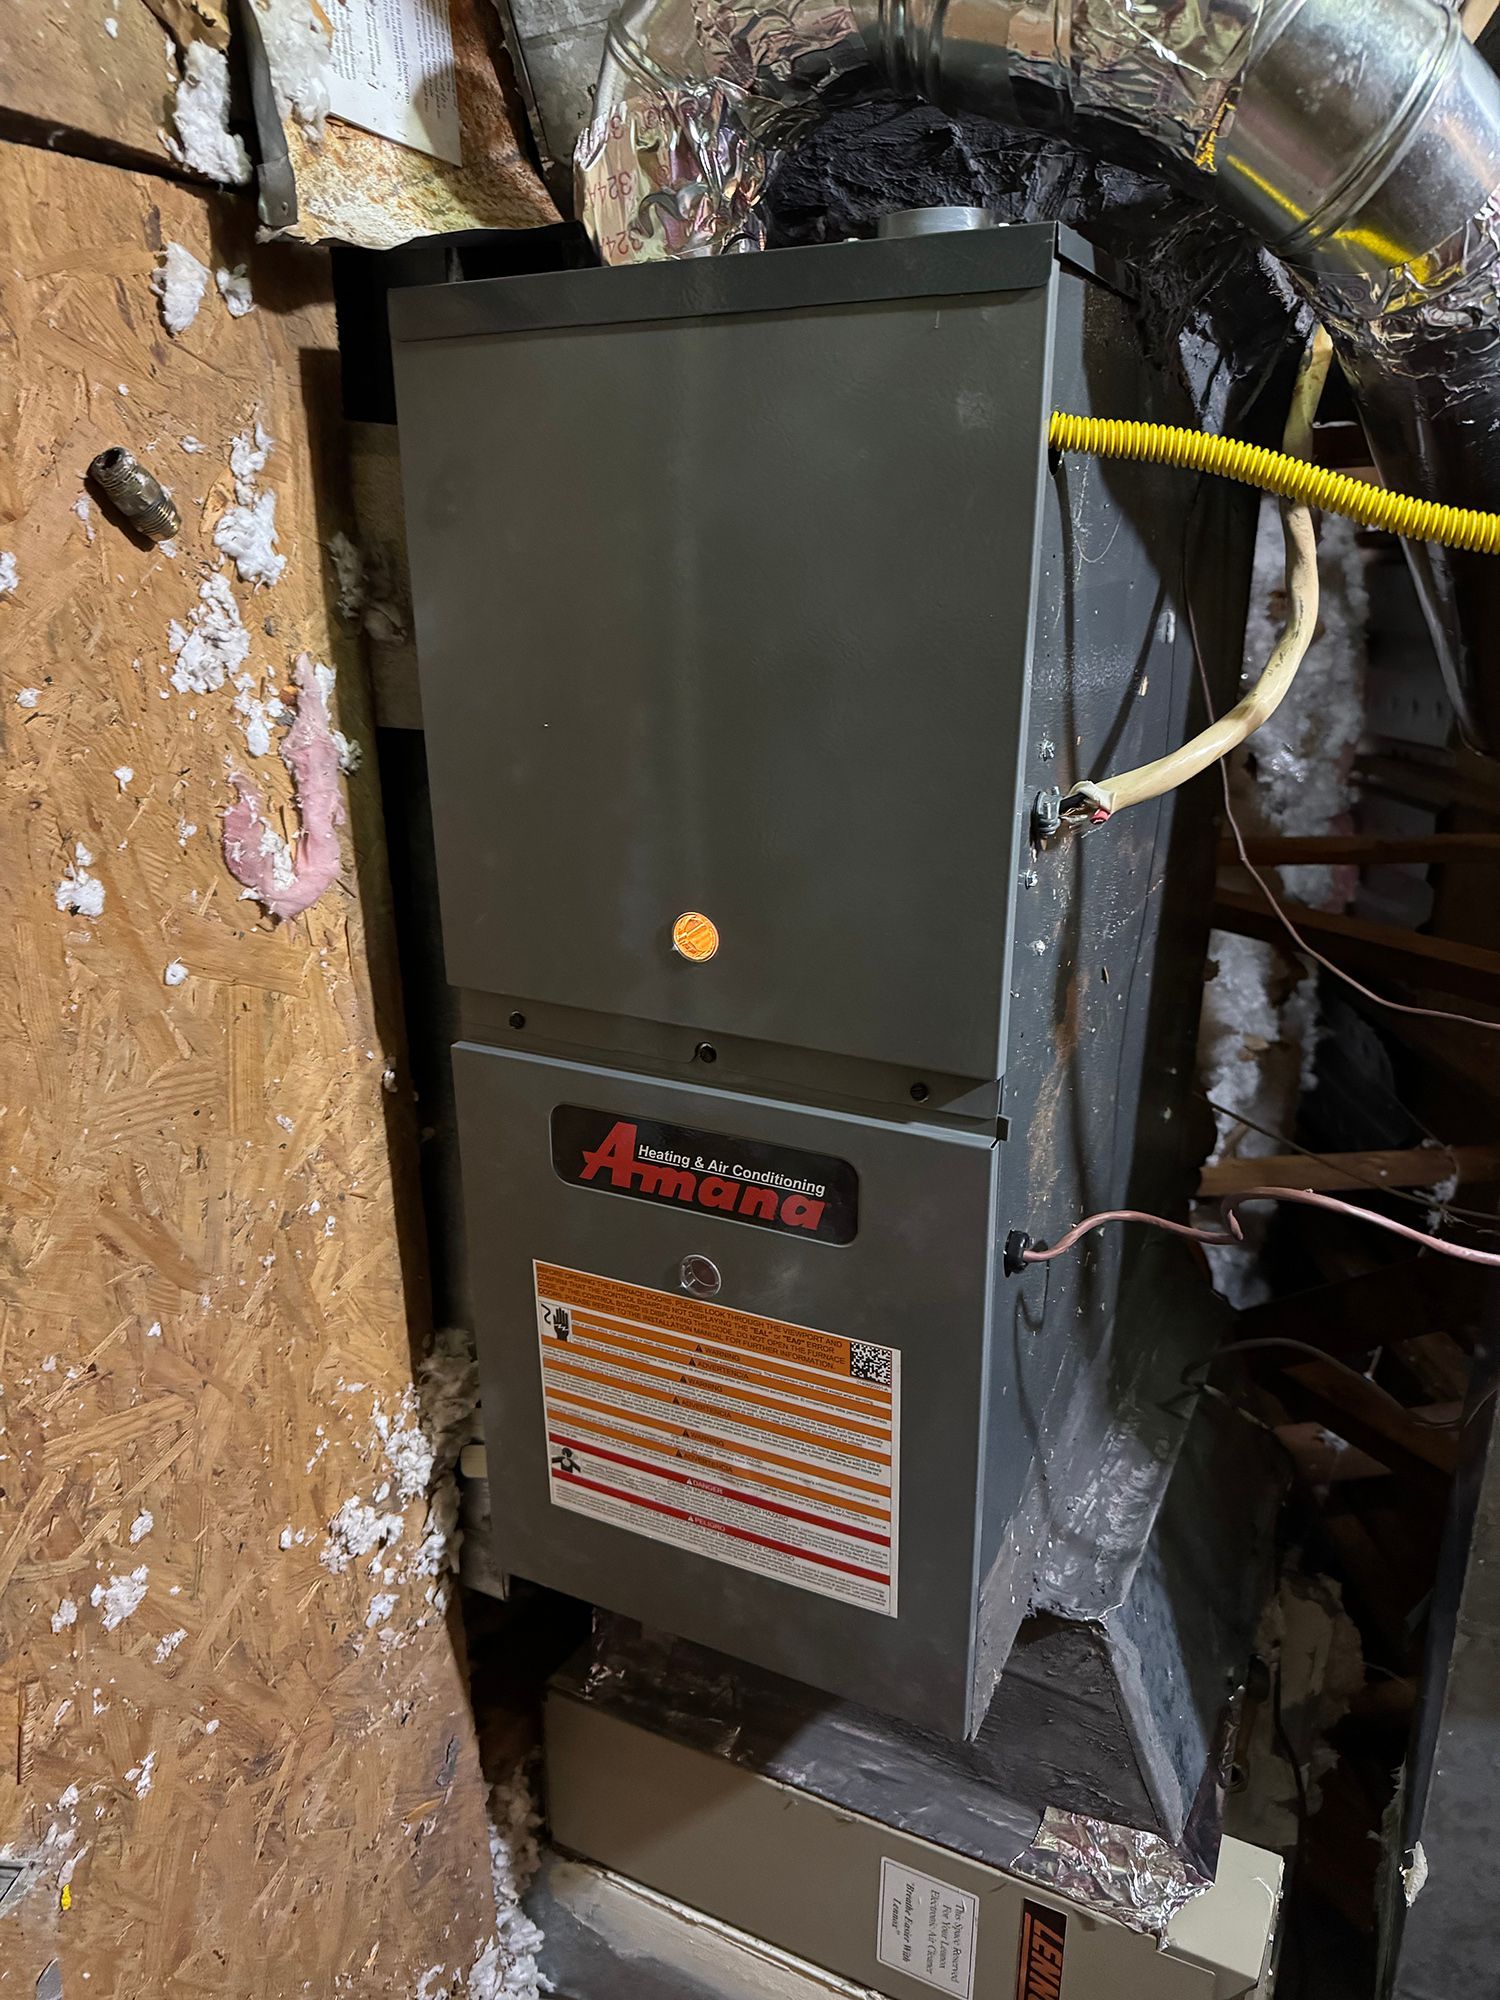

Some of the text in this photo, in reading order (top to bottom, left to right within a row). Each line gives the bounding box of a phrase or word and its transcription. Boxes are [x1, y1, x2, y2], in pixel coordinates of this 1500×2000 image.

[579, 1121, 826, 1230] Amana
[638, 1144, 826, 1197] Heating & Air Conditioning
[567, 1288, 580, 1297] THE
[582, 1291, 614, 1306] CONTROL
[616, 1300, 640, 1312] BOARD
[641, 1306, 647, 1314] IS
[649, 1308, 691, 1325] DISPLAYING
[693, 1319, 709, 1330] THIS
[736, 1330, 747, 1340] DO
[749, 1333, 764, 1344] NOT
[767, 1338, 788, 1350] OPEN
[791, 1344, 805, 1354] THE
[807, 1348, 844, 1364] FURNACE
[568, 1281, 585, 1291] THAT
[588, 1285, 600, 1295] THE
[602, 1289, 635, 1303] CONTROL
[637, 1298, 661, 1310] BOARD
[663, 1304, 670, 1312] IS
[672, 1306, 686, 1316] NOT
[688, 1310, 731, 1328] DISPLAYING
[734, 1322, 748, 1332] THE
[774, 1332, 780, 1340] or
[806, 1340, 834, 1353] ERROR
[617, 1307, 626, 1316] TO
[627, 1310, 640, 1320] THE
[642, 1314, 692, 1333] INSTALLATION
[725, 1335, 740, 1345] FOR
[742, 1339, 777, 1355] FURTHER
[675, 1299, 702, 1313] PLEASE
[705, 1307, 725, 1318] LOOK
[726, 1312, 764, 1328] THROUGH
[766, 1322, 781, 1332] THE
[782, 1326, 823, 1343] VIEWPORT
[825, 1337, 842, 1348] AND
[704, 1346, 740, 1362] WARNING
[688, 1376, 722, 1392] WARNING
[697, 1359, 748, 1380] ADVERTENCIA
[681, 1398, 731, 1419] ADVERTENCIA
[690, 1431, 724, 1447] WARNING
[683, 1452, 732, 1473] ADVERTENCIA
[692, 1479, 723, 1494] DANGER
[694, 1516, 725, 1532] PELIGRO
[928, 1889, 939, 1929] Electronic
[903, 1916, 913, 1942] Easier
[939, 1904, 952, 1969] For Your Lennox
[950, 1903, 965, 1984] This Space Reserved
[902, 1941, 913, 1962] With
[926, 1942, 937, 1974] Cleaner
